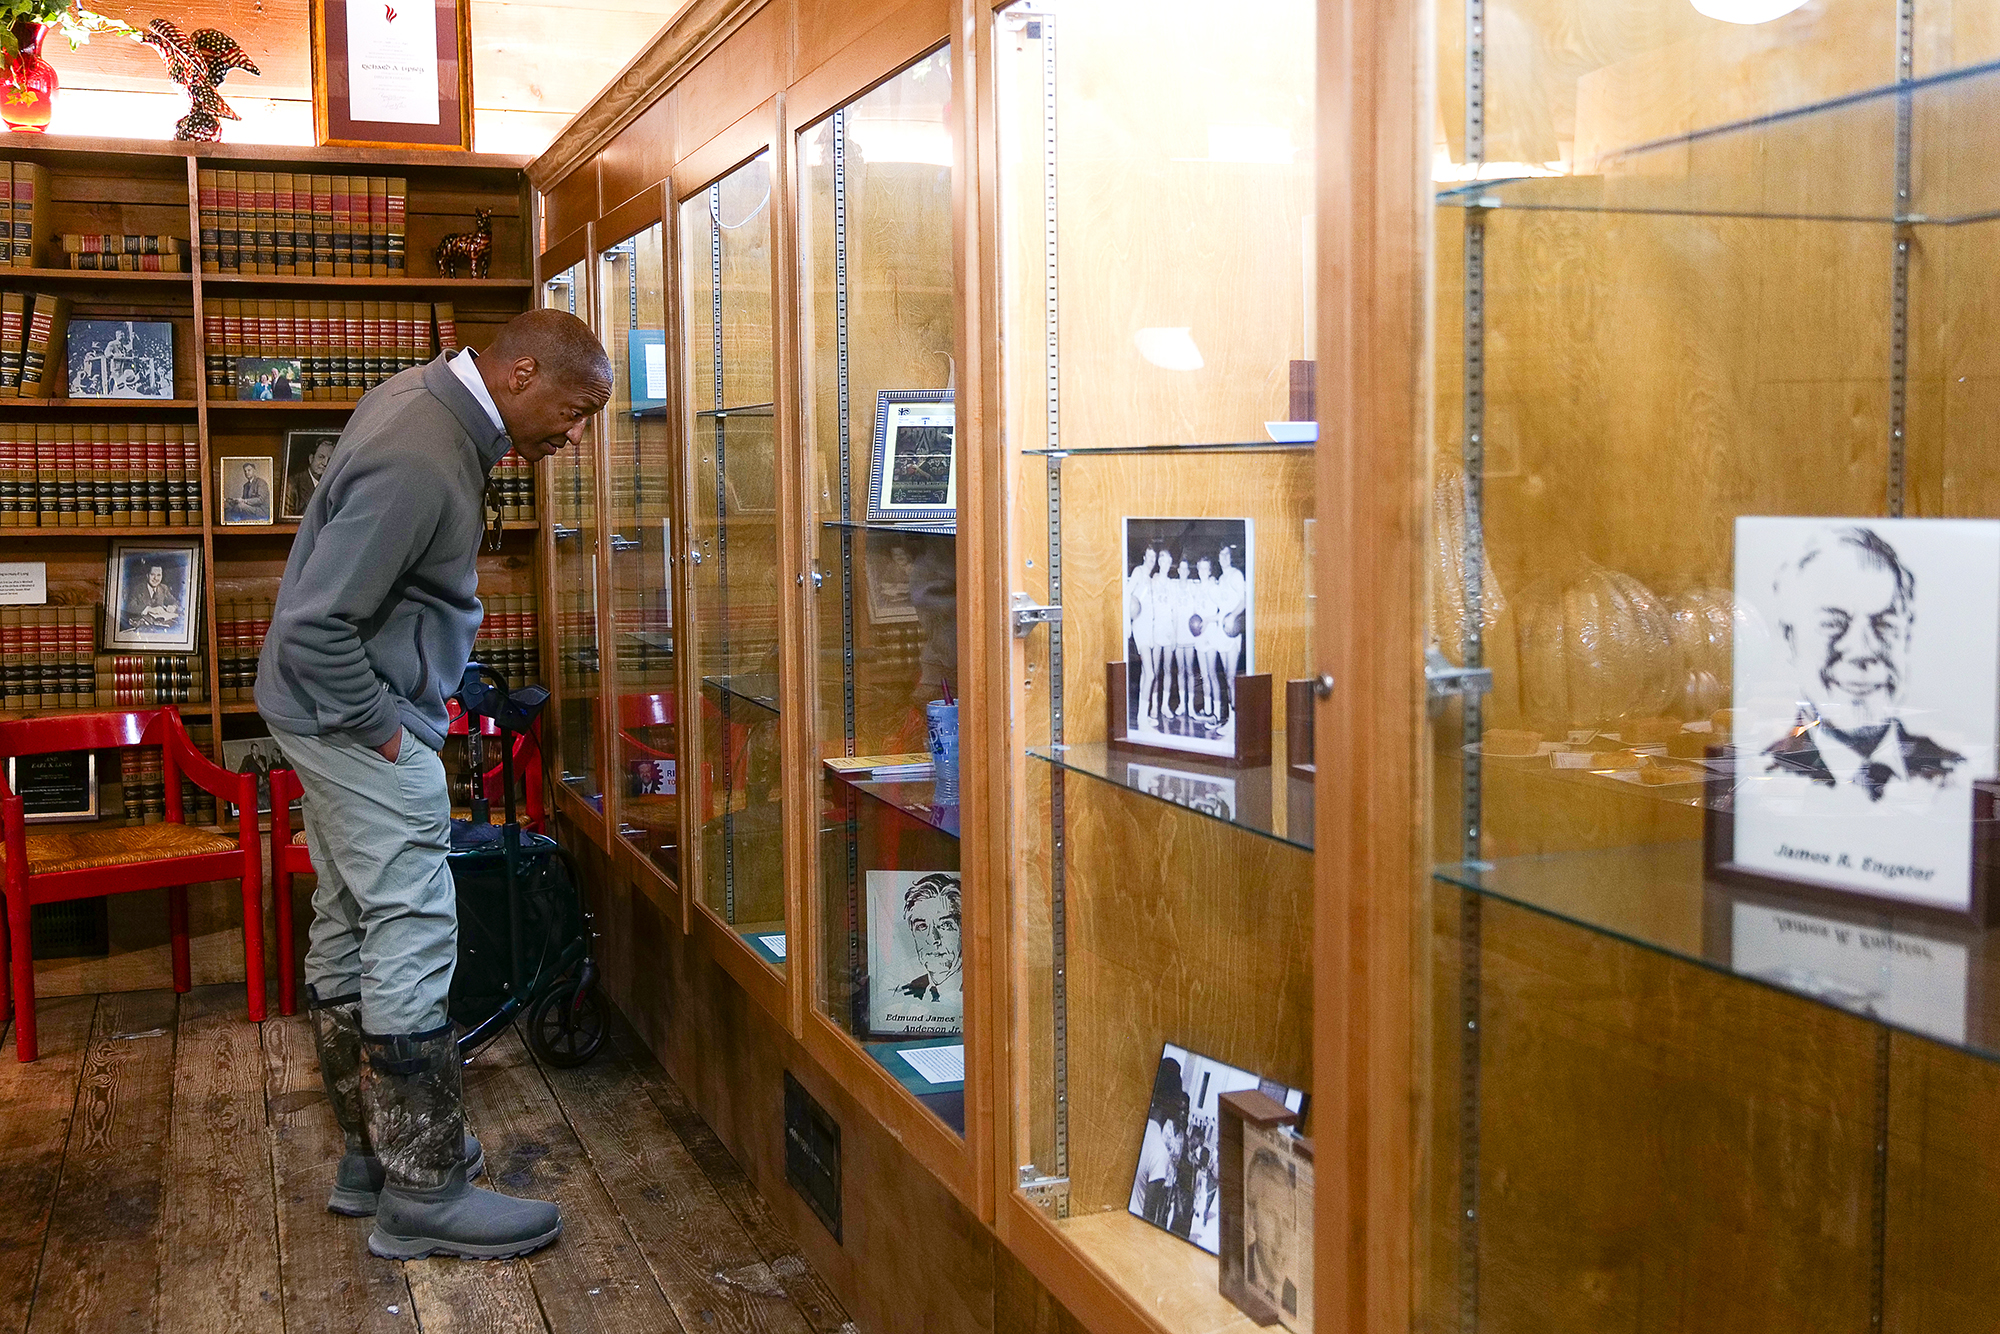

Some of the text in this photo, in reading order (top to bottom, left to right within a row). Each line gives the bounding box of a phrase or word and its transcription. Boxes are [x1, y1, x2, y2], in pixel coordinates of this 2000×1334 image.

[1774, 843, 1935, 880] James R. Engster
[886, 1014, 924, 1022] Edmund
[903, 1025, 946, 1033] Anderson
